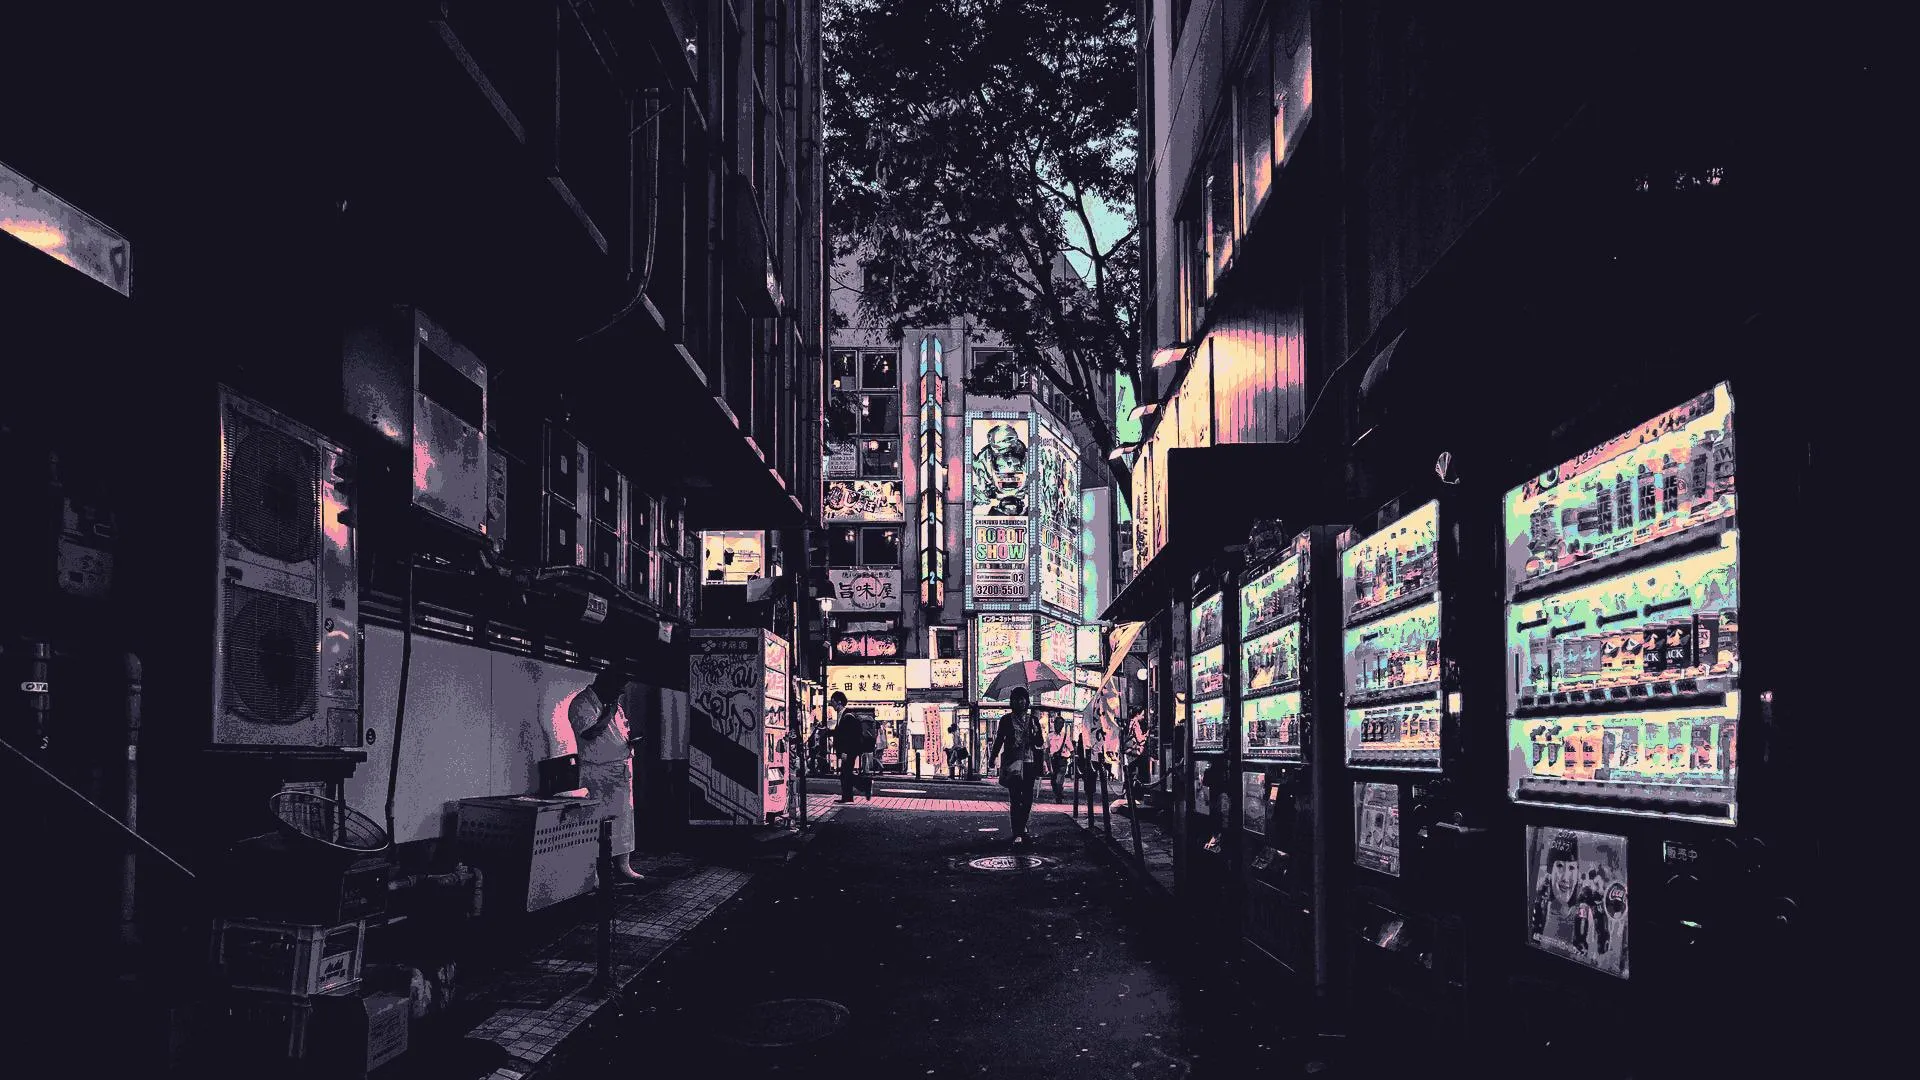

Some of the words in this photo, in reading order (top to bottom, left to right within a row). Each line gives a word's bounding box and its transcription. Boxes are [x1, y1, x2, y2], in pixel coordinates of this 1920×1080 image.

[929, 512, 935, 524] 3
[976, 527, 1025, 543] ROBOT
[976, 543, 1026, 560] SHOW
[929, 571, 936, 584] 2
[1013, 573, 1024, 582] 03
[839, 582, 896, 600] 旨味屋
[976, 585, 1025, 595] 3200-5500
